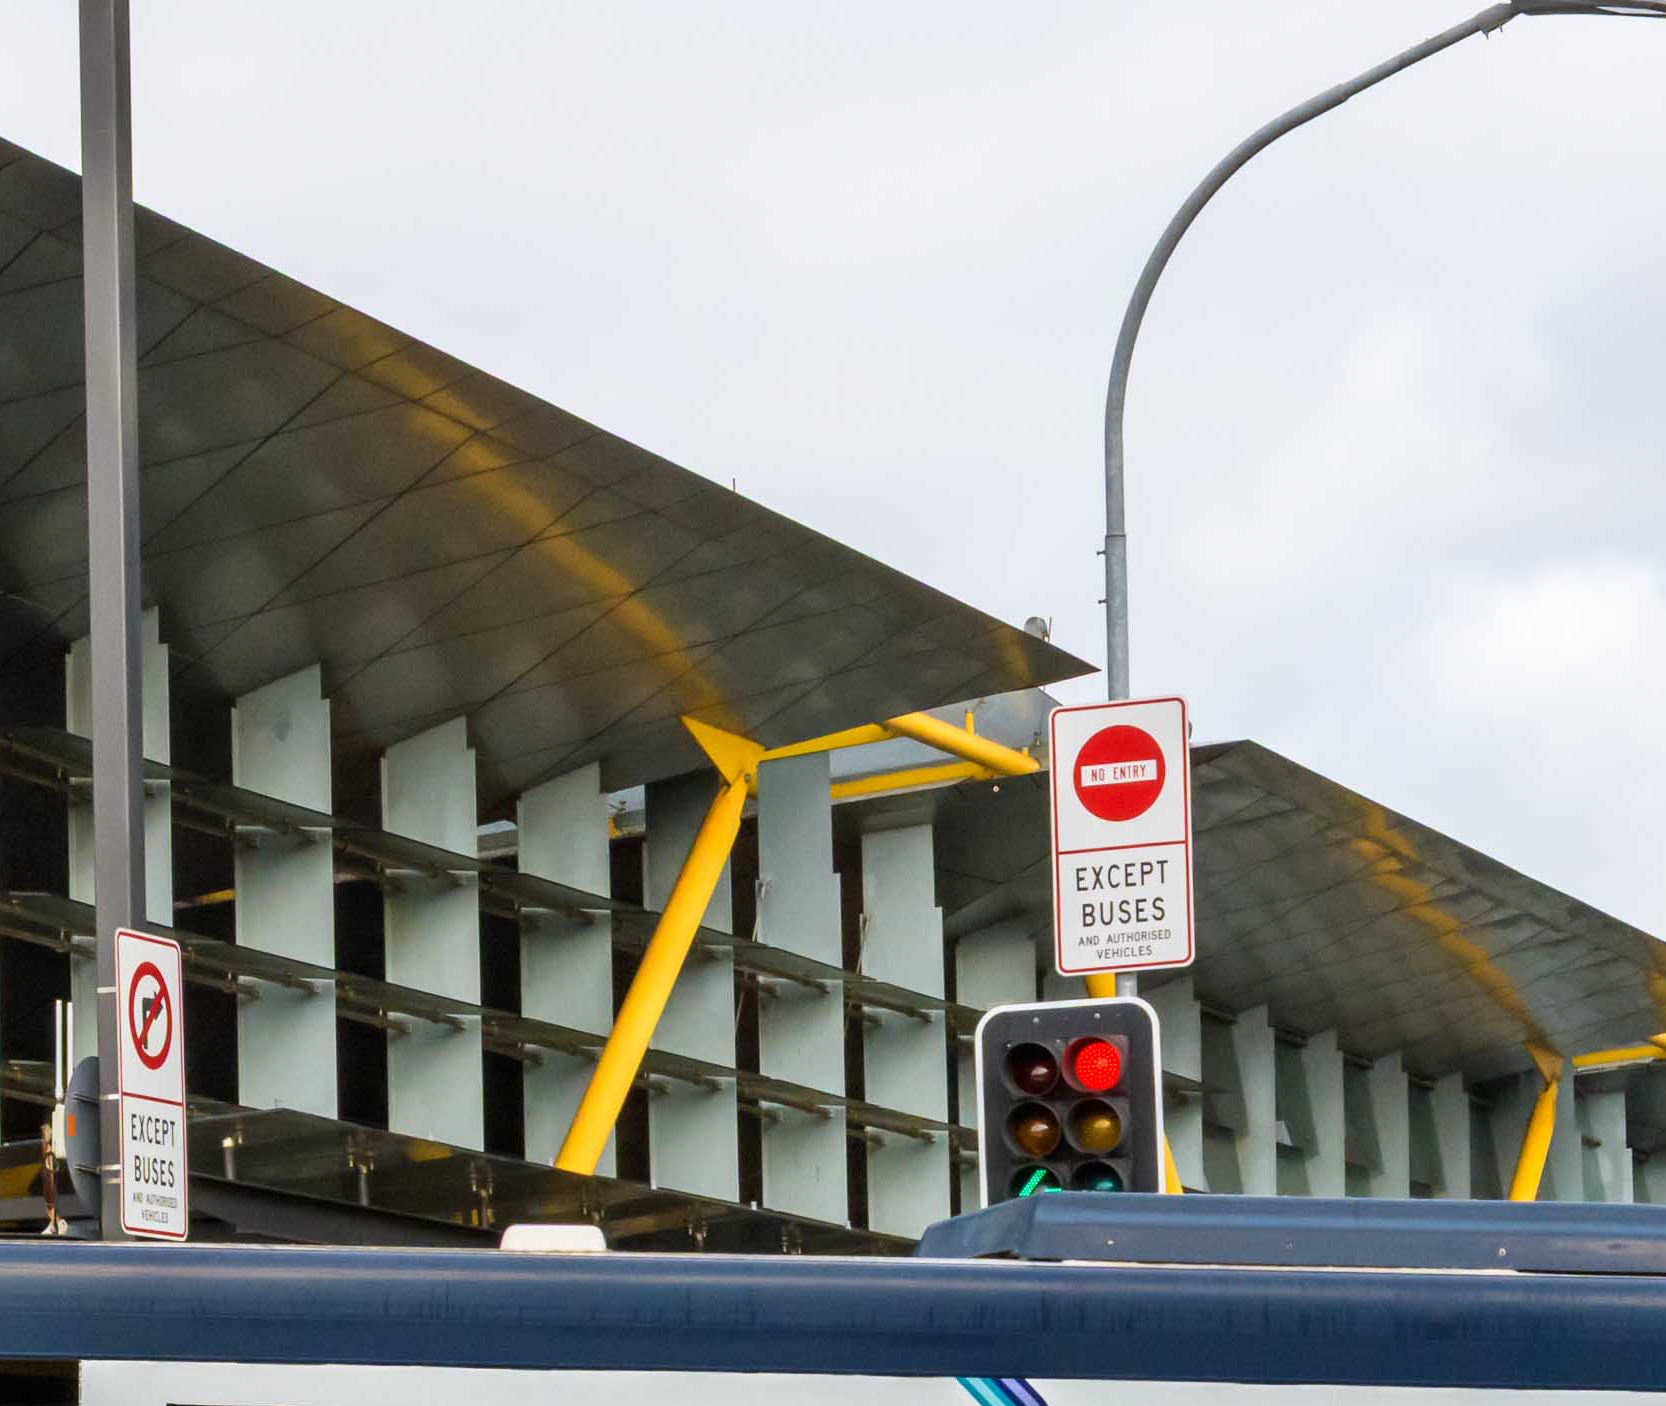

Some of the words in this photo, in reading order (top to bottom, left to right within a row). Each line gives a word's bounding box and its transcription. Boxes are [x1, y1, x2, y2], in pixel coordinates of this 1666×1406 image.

[1091, 768, 1106, 782] NO
[1113, 763, 1147, 780] ENTRY
[1076, 860, 1169, 892] EXCEPT
[1082, 896, 1166, 928] BUSES
[1078, 935, 1100, 946] AND
[1106, 929, 1172, 945] AUTHORISED
[1096, 945, 1153, 960] VEHICLES
[131, 1113, 175, 1147] EXCEPT
[134, 1155, 174, 1188] BUSES
